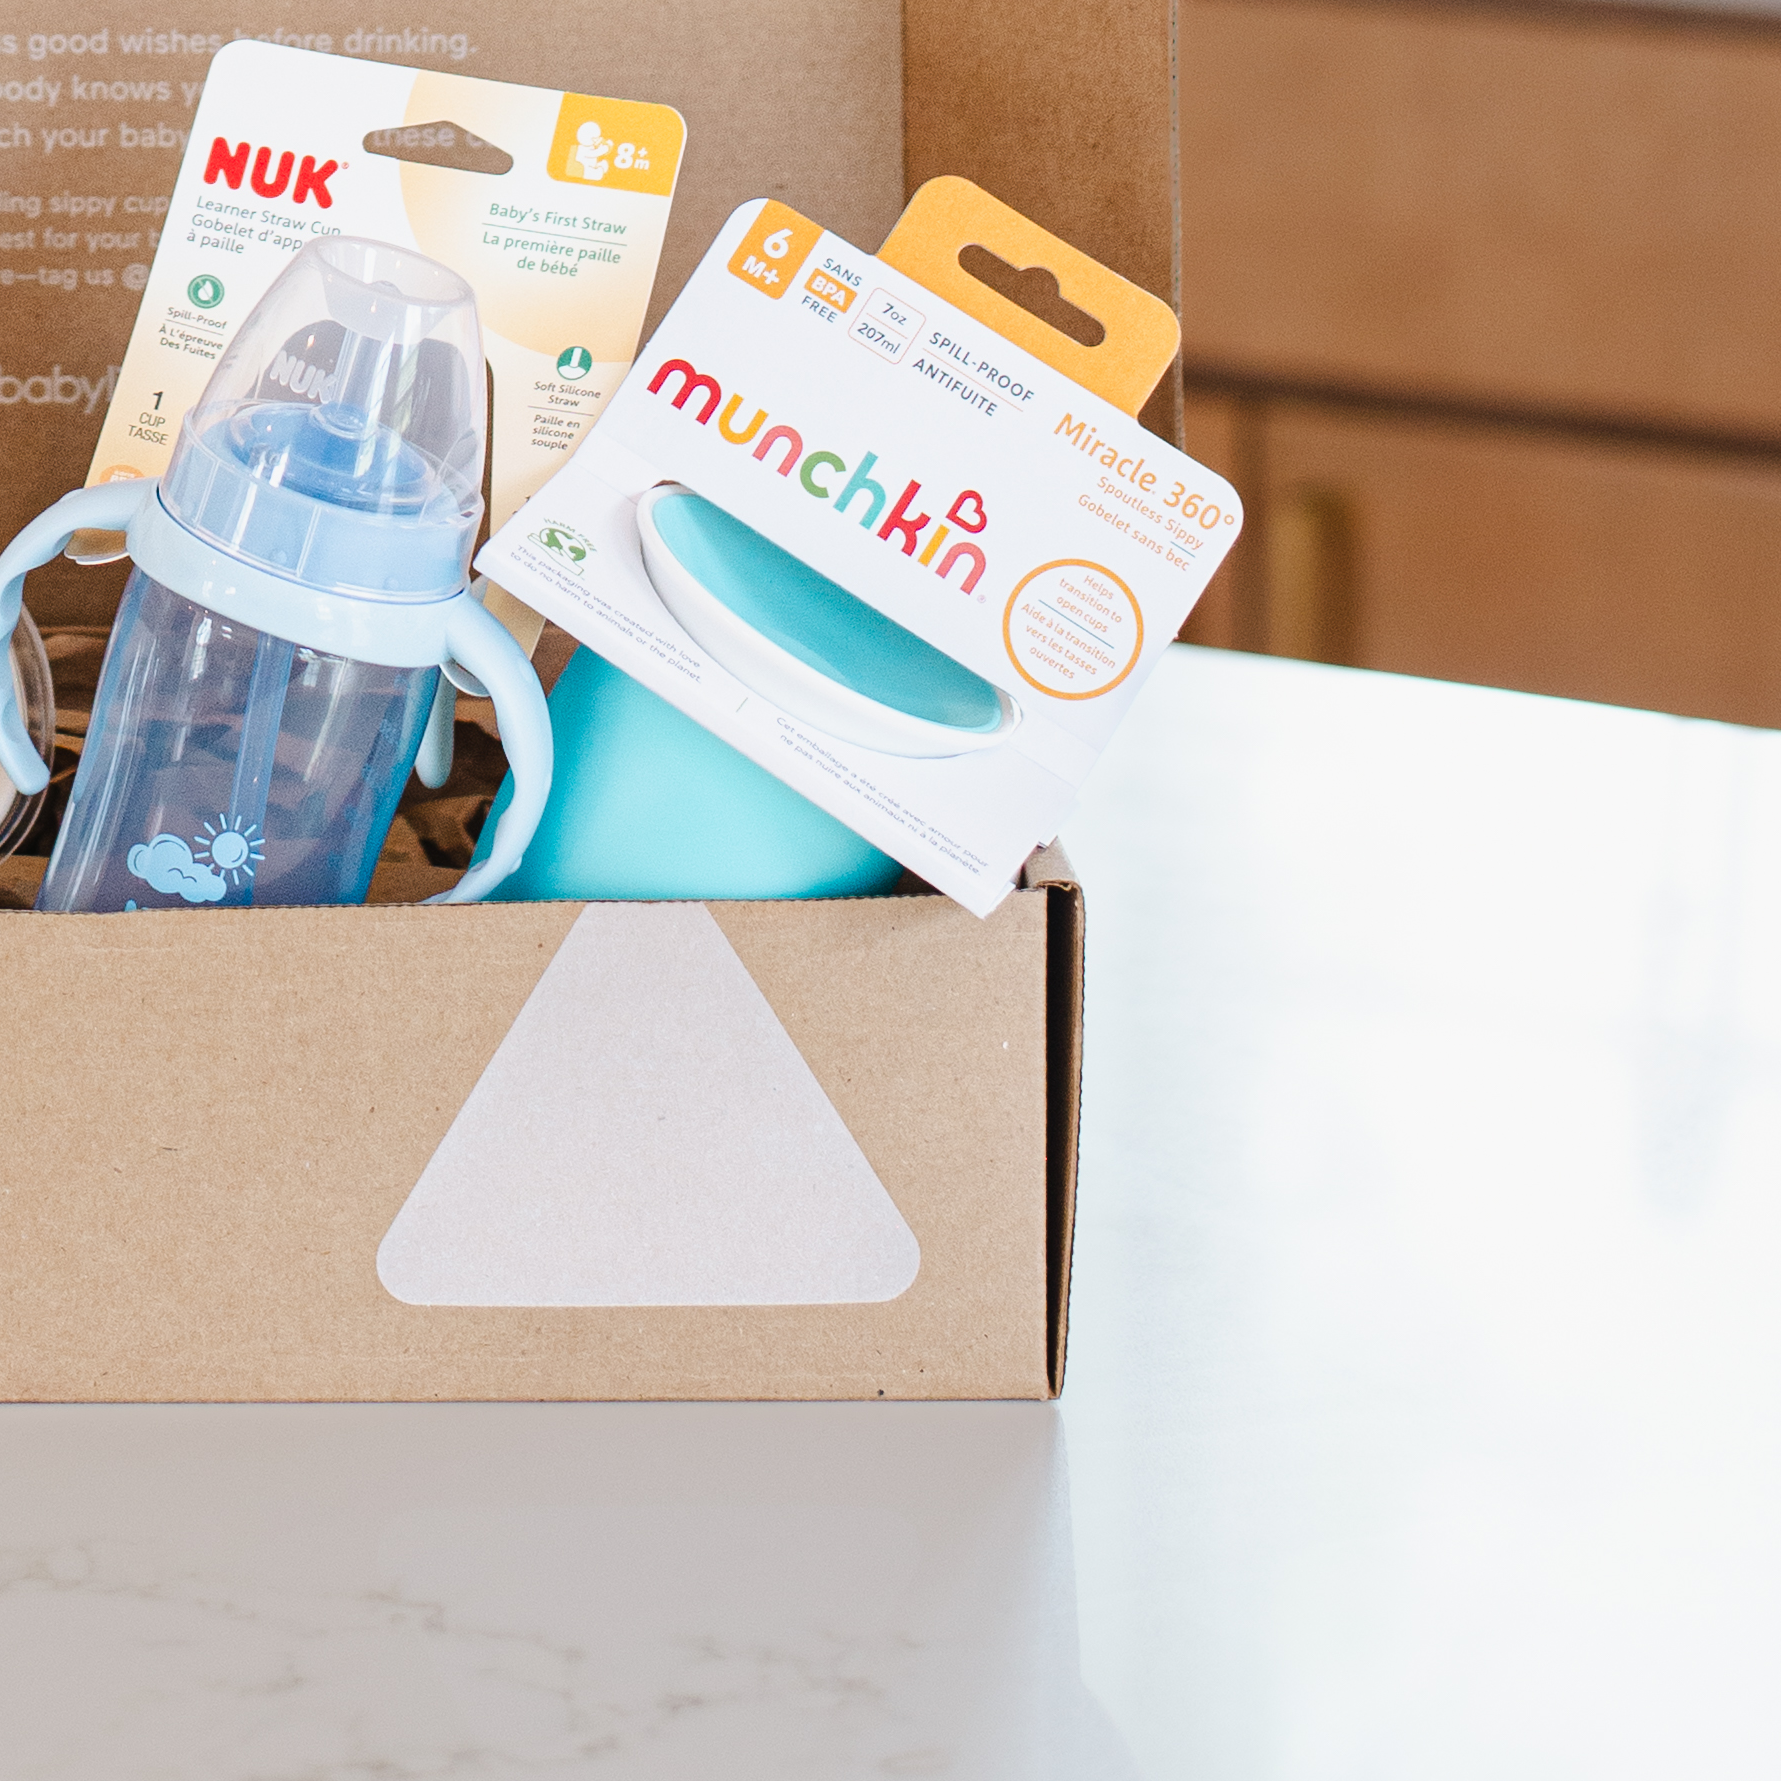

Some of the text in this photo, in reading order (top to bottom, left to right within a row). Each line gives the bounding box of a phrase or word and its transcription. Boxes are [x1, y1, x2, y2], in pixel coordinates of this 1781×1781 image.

[27, 27, 109, 61] good
[120, 27, 223, 54] wishes
[343, 26, 479, 61] drinking.
[73, 75, 171, 101] knows
[40, 126, 110, 155] your
[204, 136, 339, 209] NUK
[49, 191, 118, 218] sippy
[197, 196, 257, 220] Learner
[260, 210, 307, 231] Straw
[489, 203, 628, 235] Baby's First Straw
[43, 227, 78, 249] for
[85, 232, 141, 254] your
[187, 230, 245, 254] à paille
[192, 214, 303, 252] Gobelet d'app
[483, 231, 622, 264] La première paille
[763, 227, 794, 260] 6
[84, 269, 115, 287] us
[517, 256, 579, 277] de bébé
[741, 254, 780, 286] M+
[823, 257, 863, 288] SANS
[810, 275, 847, 307] BPA
[167, 306, 228, 330] Spill-Proof
[801, 295, 838, 324] FREE
[882, 303, 908, 326] 7oz
[160, 338, 216, 360] Des Fuites
[170, 327, 224, 351] L'épreuve
[857, 322, 902, 355] 207ml
[270, 350, 337, 404] NUK
[929, 332, 1035, 402] SPILL-PROOF
[153, 391, 164, 410] 1
[534, 381, 602, 399] Soft Silicone
[548, 395, 580, 407] Straw
[912, 358, 998, 417] ANTIFUITE
[128, 425, 169, 446] TASSE
[139, 412, 166, 427] CUP
[532, 426, 575, 440] silicone
[534, 414, 581, 429] Paille en
[531, 438, 569, 451] souple
[646, 359, 987, 596] munchkin
[1053, 412, 1235, 530] Miracle 360°
[1097, 476, 1204, 551] Spoutless Sippy
[1078, 494, 1191, 572] Gobelet sans bec
[1059, 578, 1123, 624] transition to
[1084, 575, 1114, 600] Helps
[518, 545, 537, 562] This
[538, 559, 591, 597] packaging
[593, 595, 612, 611] was
[655, 634, 677, 653] with
[679, 650, 701, 669] love
[539, 571, 553, 583] no
[555, 581, 582, 602] harm
[649, 644, 667, 660] the
[1056, 596, 1109, 634] open cups
[1021, 603, 1116, 669] Aide transition
[1026, 625, 1098, 676] vers les tasses
[1029, 646, 1076, 680] ouvertes
[776, 717, 796, 734] Cet
